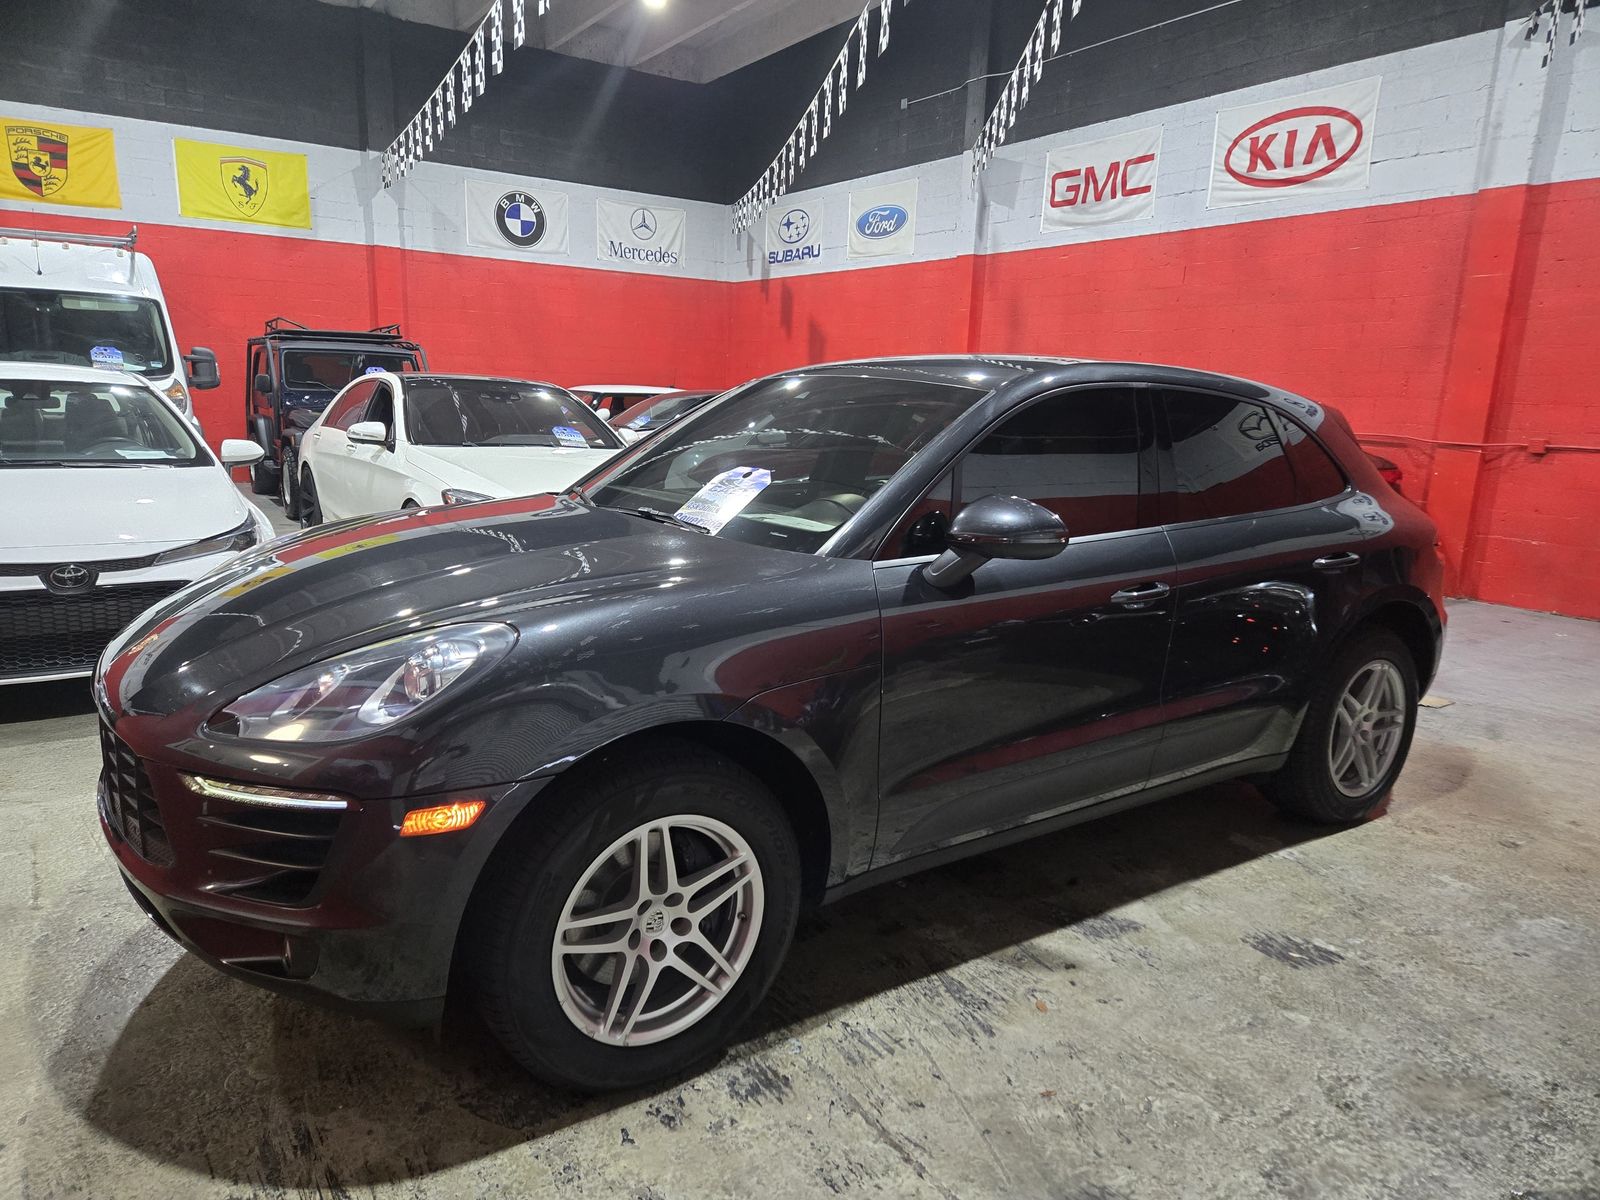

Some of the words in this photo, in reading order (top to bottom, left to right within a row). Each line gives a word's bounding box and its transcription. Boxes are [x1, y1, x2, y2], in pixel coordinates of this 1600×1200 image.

[7, 127, 66, 143] PORSCHE
[1247, 123, 1338, 173] KIA
[1050, 153, 1155, 208] GMC
[500, 193, 541, 213] BMW
[864, 210, 898, 234] Ford
[608, 240, 678, 264] Mercedes
[768, 244, 821, 264] SUBARU
